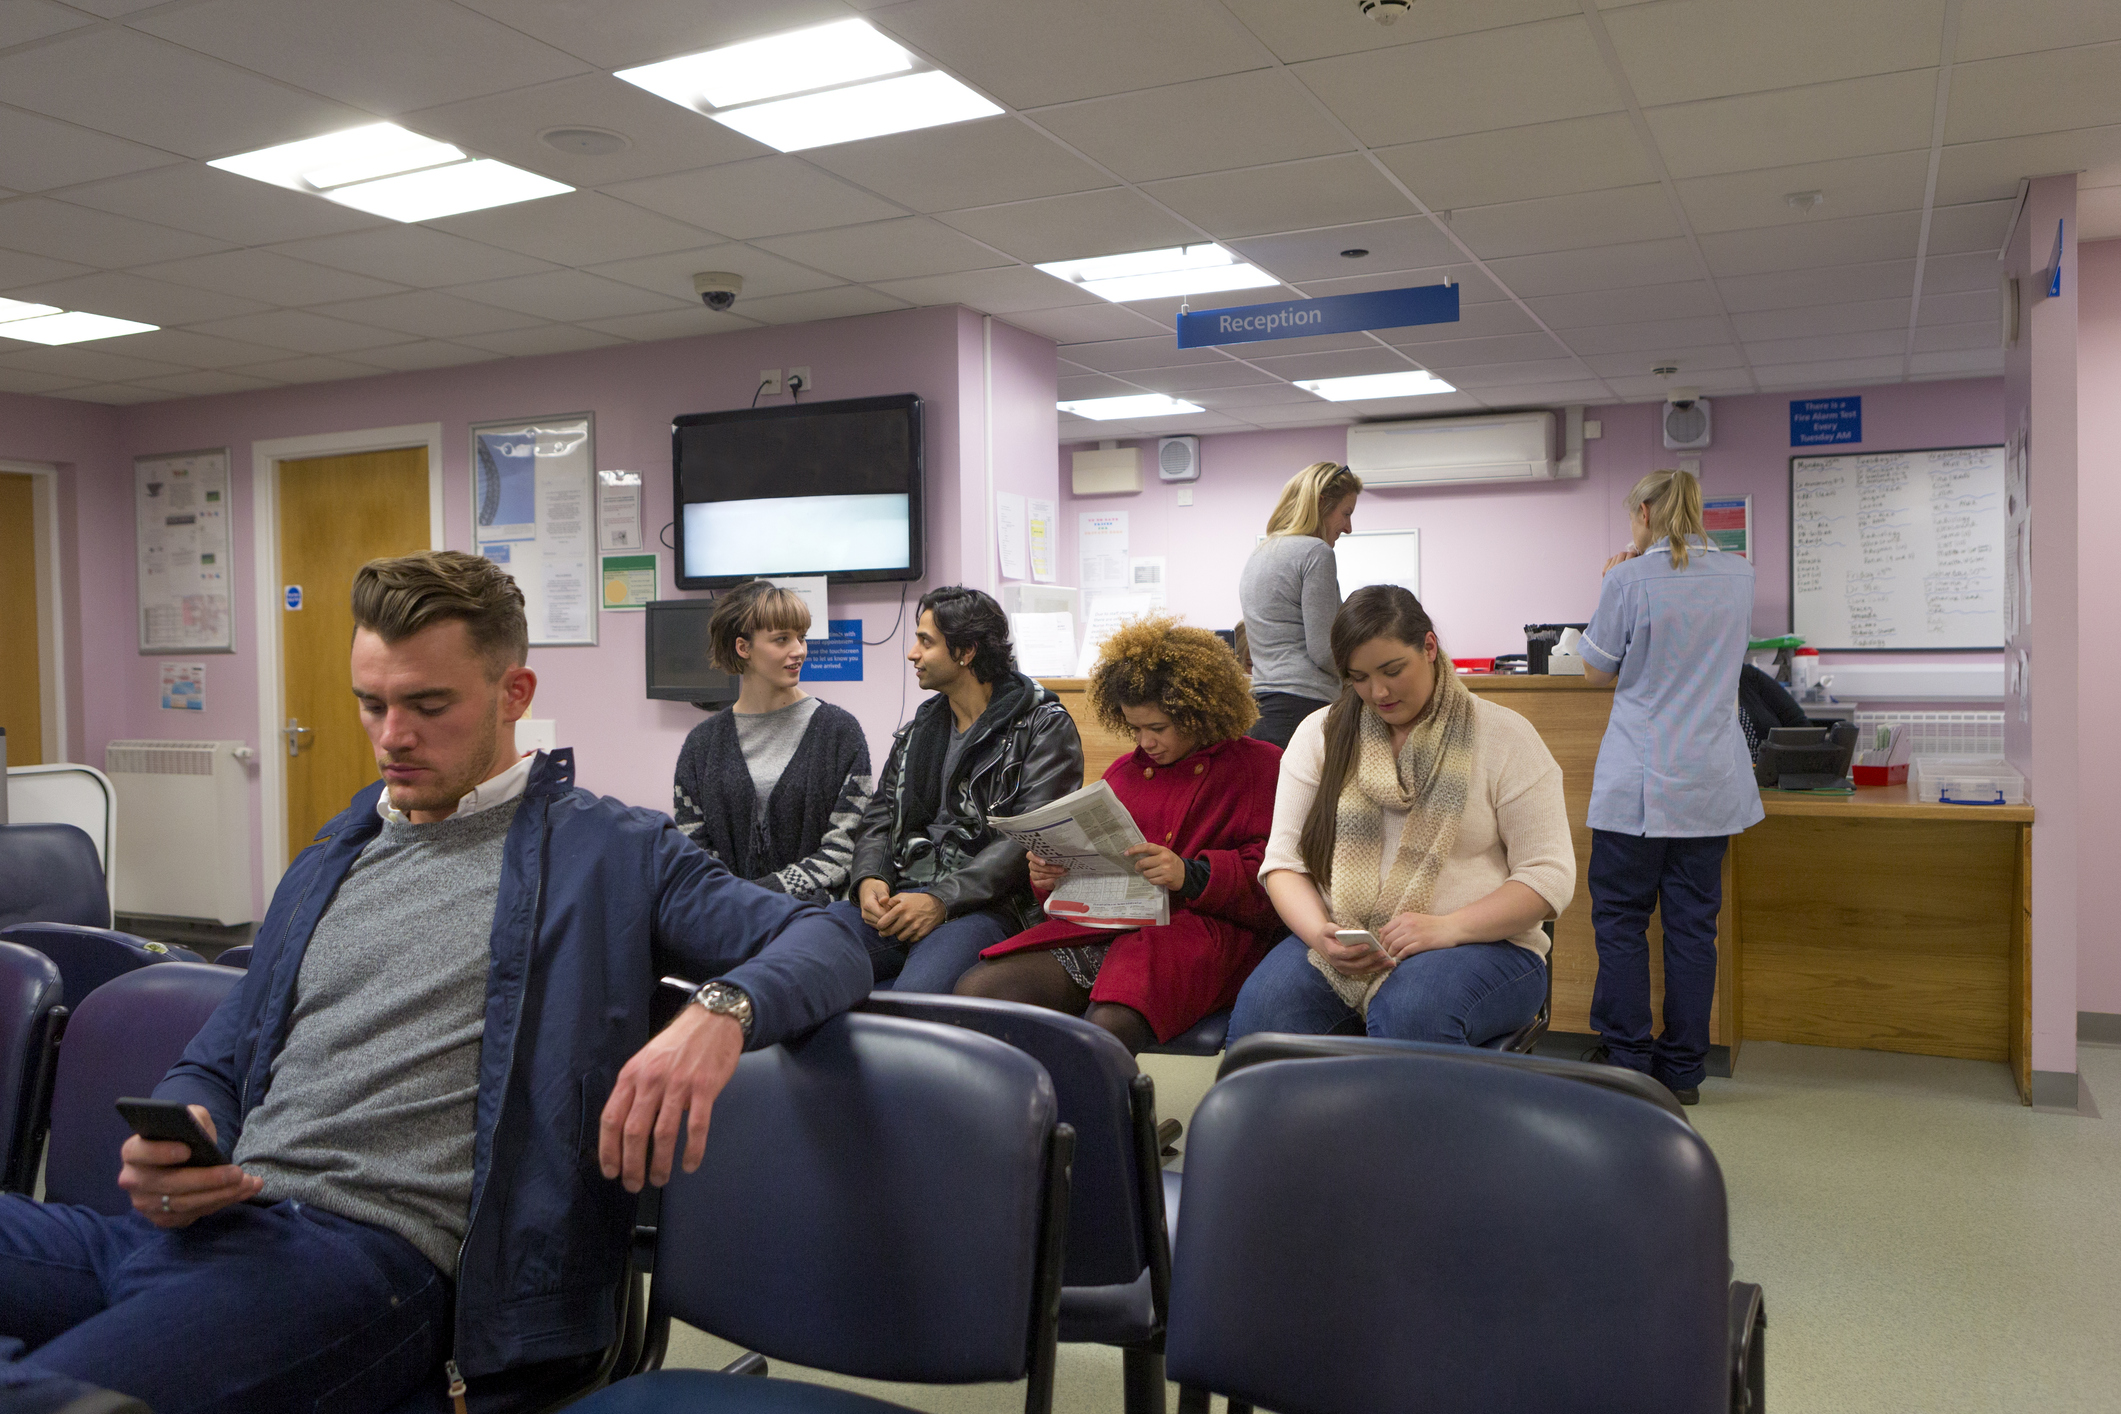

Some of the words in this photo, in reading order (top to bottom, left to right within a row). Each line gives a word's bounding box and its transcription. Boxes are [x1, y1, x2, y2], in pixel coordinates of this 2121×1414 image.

[1220, 307, 1321, 332] Reception
[1805, 402, 1829, 410] There
[1830, 401, 1838, 409] is
[1794, 414, 1810, 422] Fire
[1812, 412, 1838, 420] Alarm
[1840, 410, 1856, 418] Test
[1814, 422, 1838, 431] Every
[1800, 432, 1834, 442] Tuesday
[1836, 431, 1852, 440] AM
